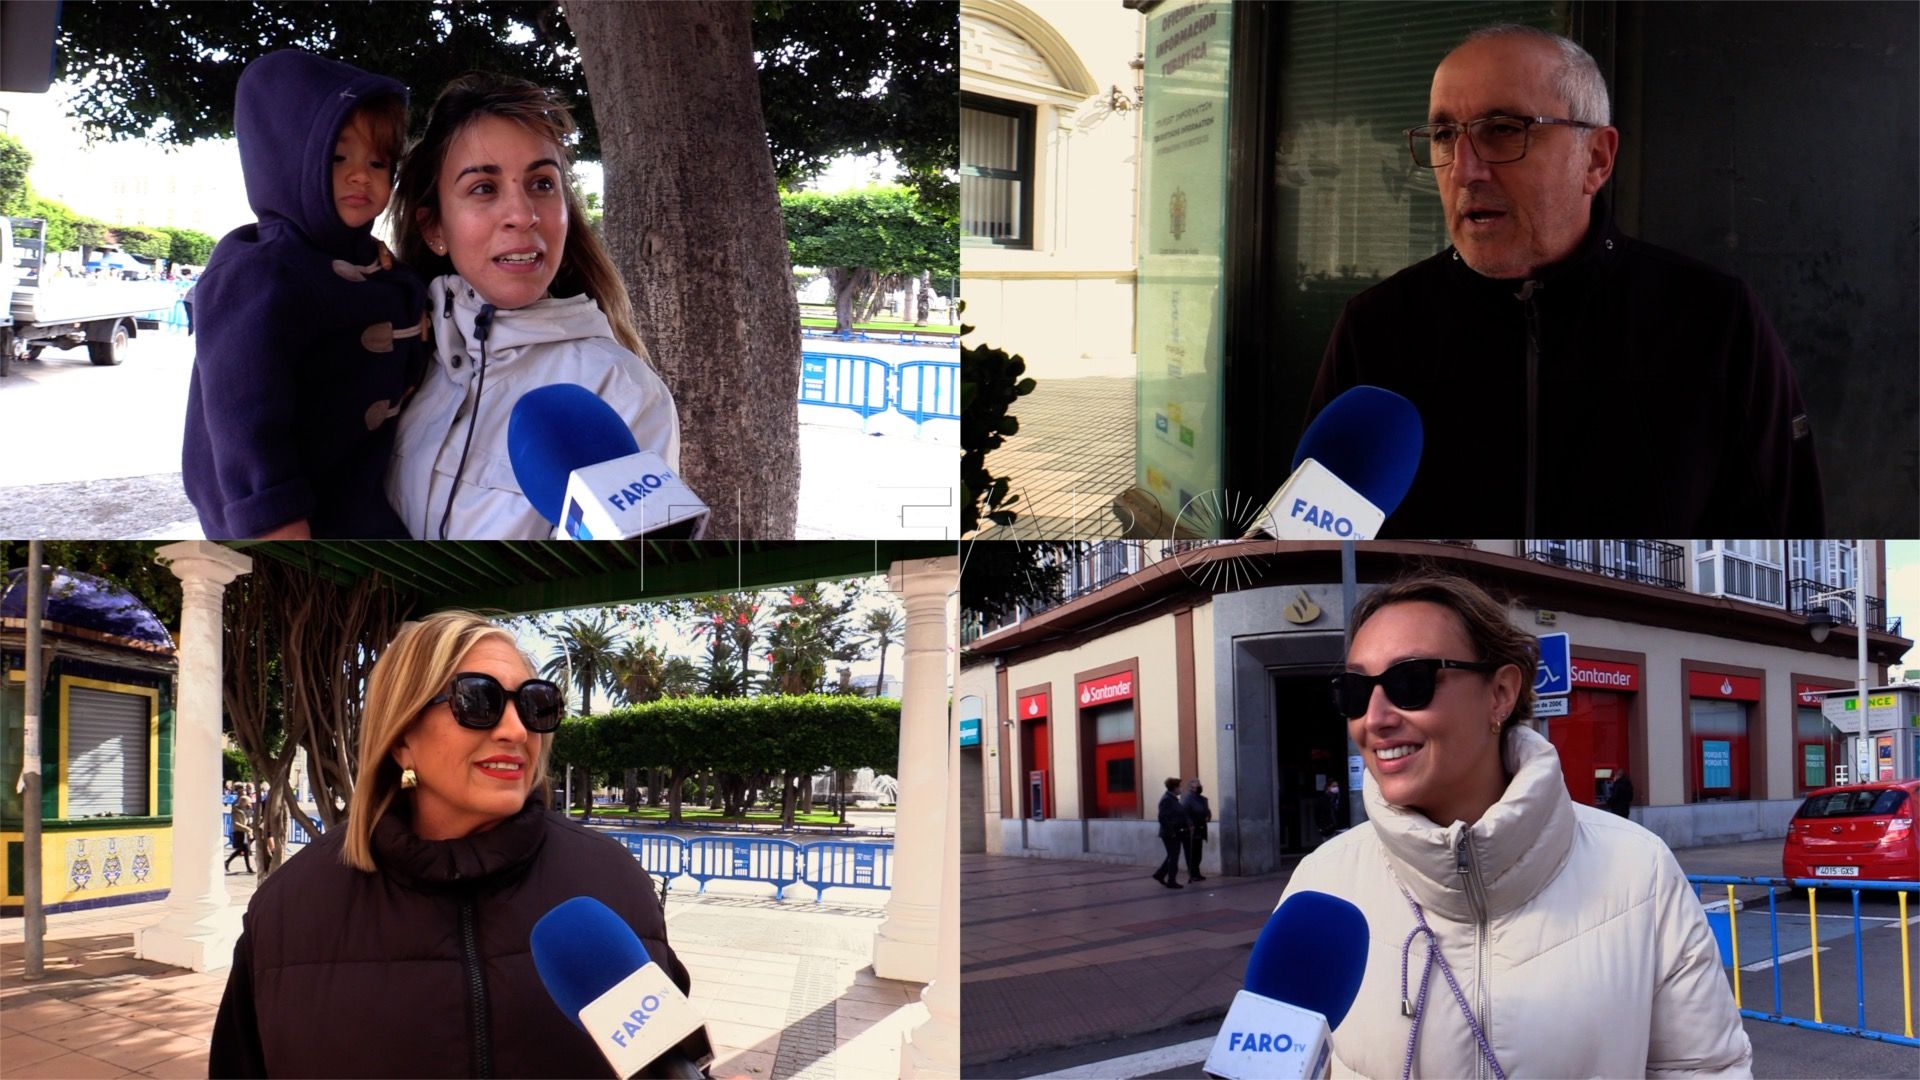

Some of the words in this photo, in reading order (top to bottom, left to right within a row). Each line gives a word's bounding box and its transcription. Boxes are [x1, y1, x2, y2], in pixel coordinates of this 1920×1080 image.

[608, 473, 662, 511] FARO
[1291, 498, 1353, 537] FARO
[1571, 665, 1631, 686] Santander
[1090, 681, 1131, 702] Santander
[611, 995, 660, 1048] FARO
[1229, 1032, 1293, 1053] FARO
[1294, 1043, 1306, 1053] TV
